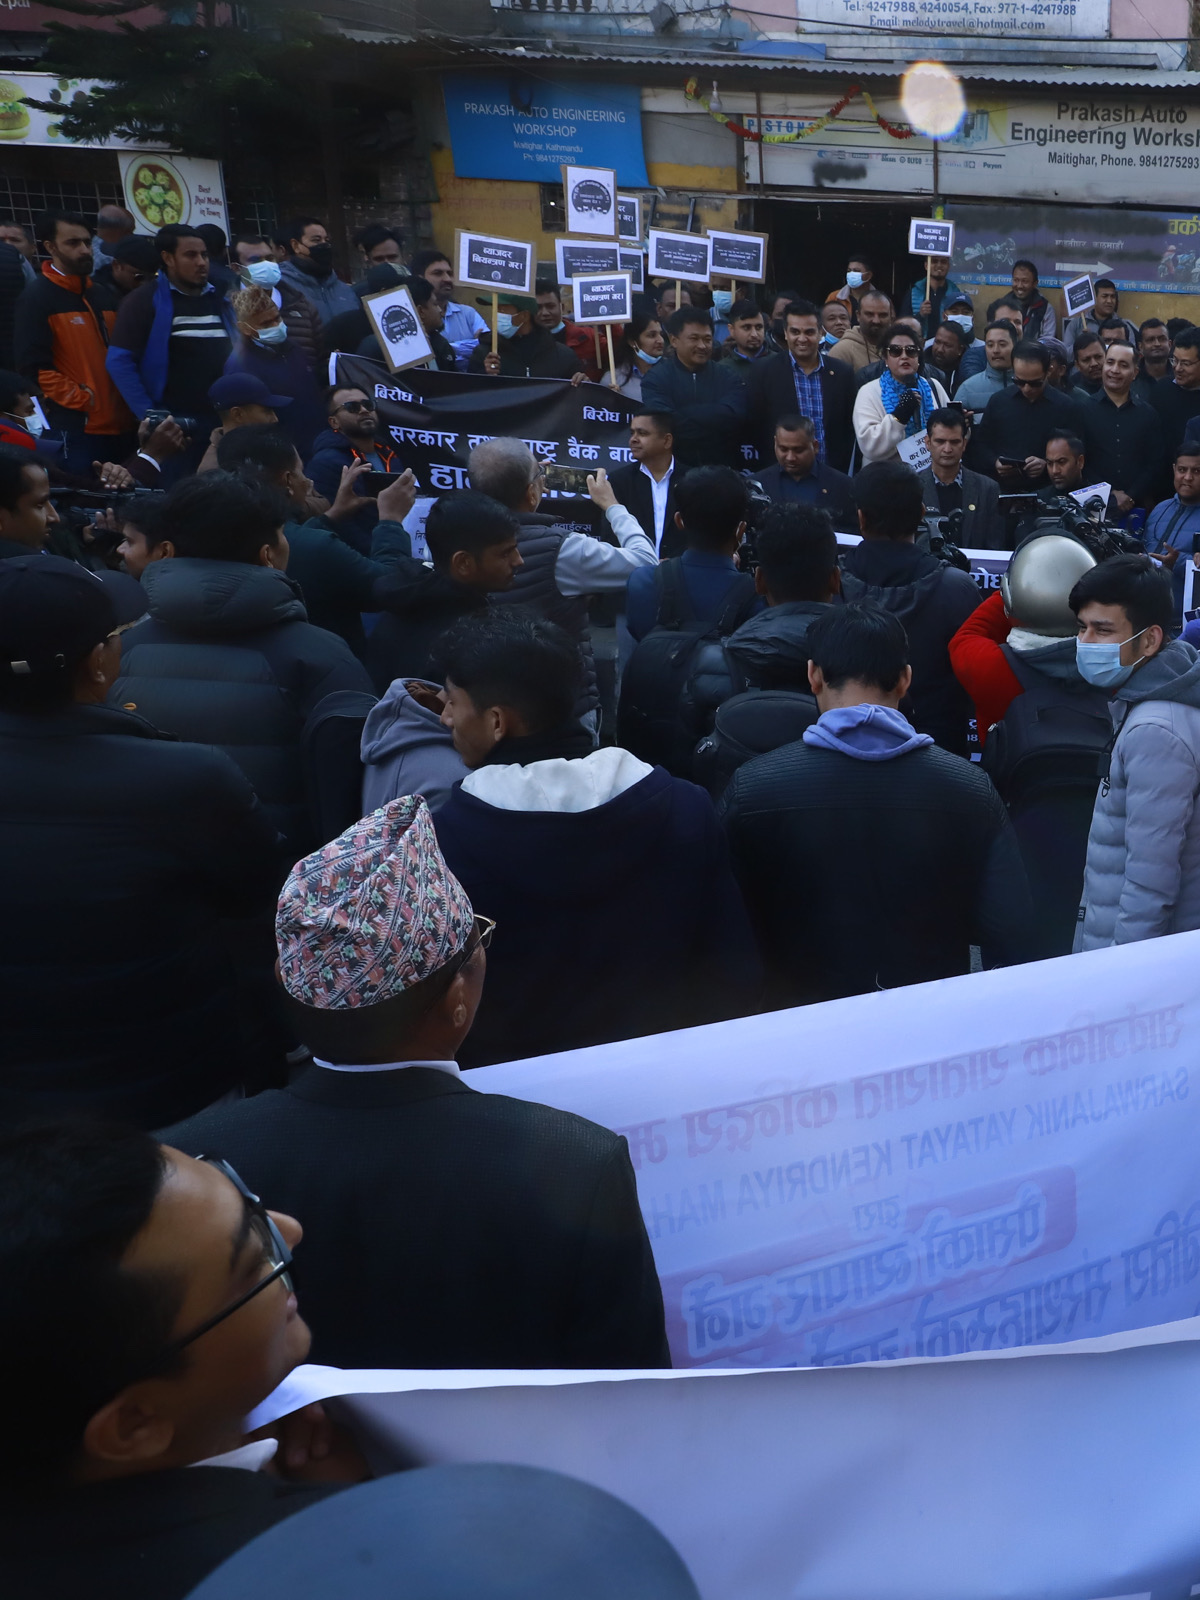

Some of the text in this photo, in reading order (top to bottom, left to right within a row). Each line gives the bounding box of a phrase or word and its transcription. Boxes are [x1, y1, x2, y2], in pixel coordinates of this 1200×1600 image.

[866, 2, 918, 14] 4247988,
[920, 3, 971, 14] 4240054,
[974, 4, 996, 14] Fax:
[998, 3, 1077, 15] 977-1-4247988
[902, 17, 1046, 31] melodytravel@hotmail.com
[464, 102, 626, 123] PRAKASH AUTO ENGINEERING
[1057, 101, 1188, 124] Prakash Auto
[513, 123, 577, 137] WORKSHOP
[1011, 122, 1127, 149] Engineering
[546, 141, 583, 153] Kathmandu
[536, 154, 576, 164] 9841275293
[1048, 152, 1200, 169] Maitighar, Phone. 9841275293
[374, 384, 414, 402] बिरोध
[583, 406, 620, 422] बिरोध
[388, 425, 459, 452] सरकार
[567, 436, 601, 460] बैंक
